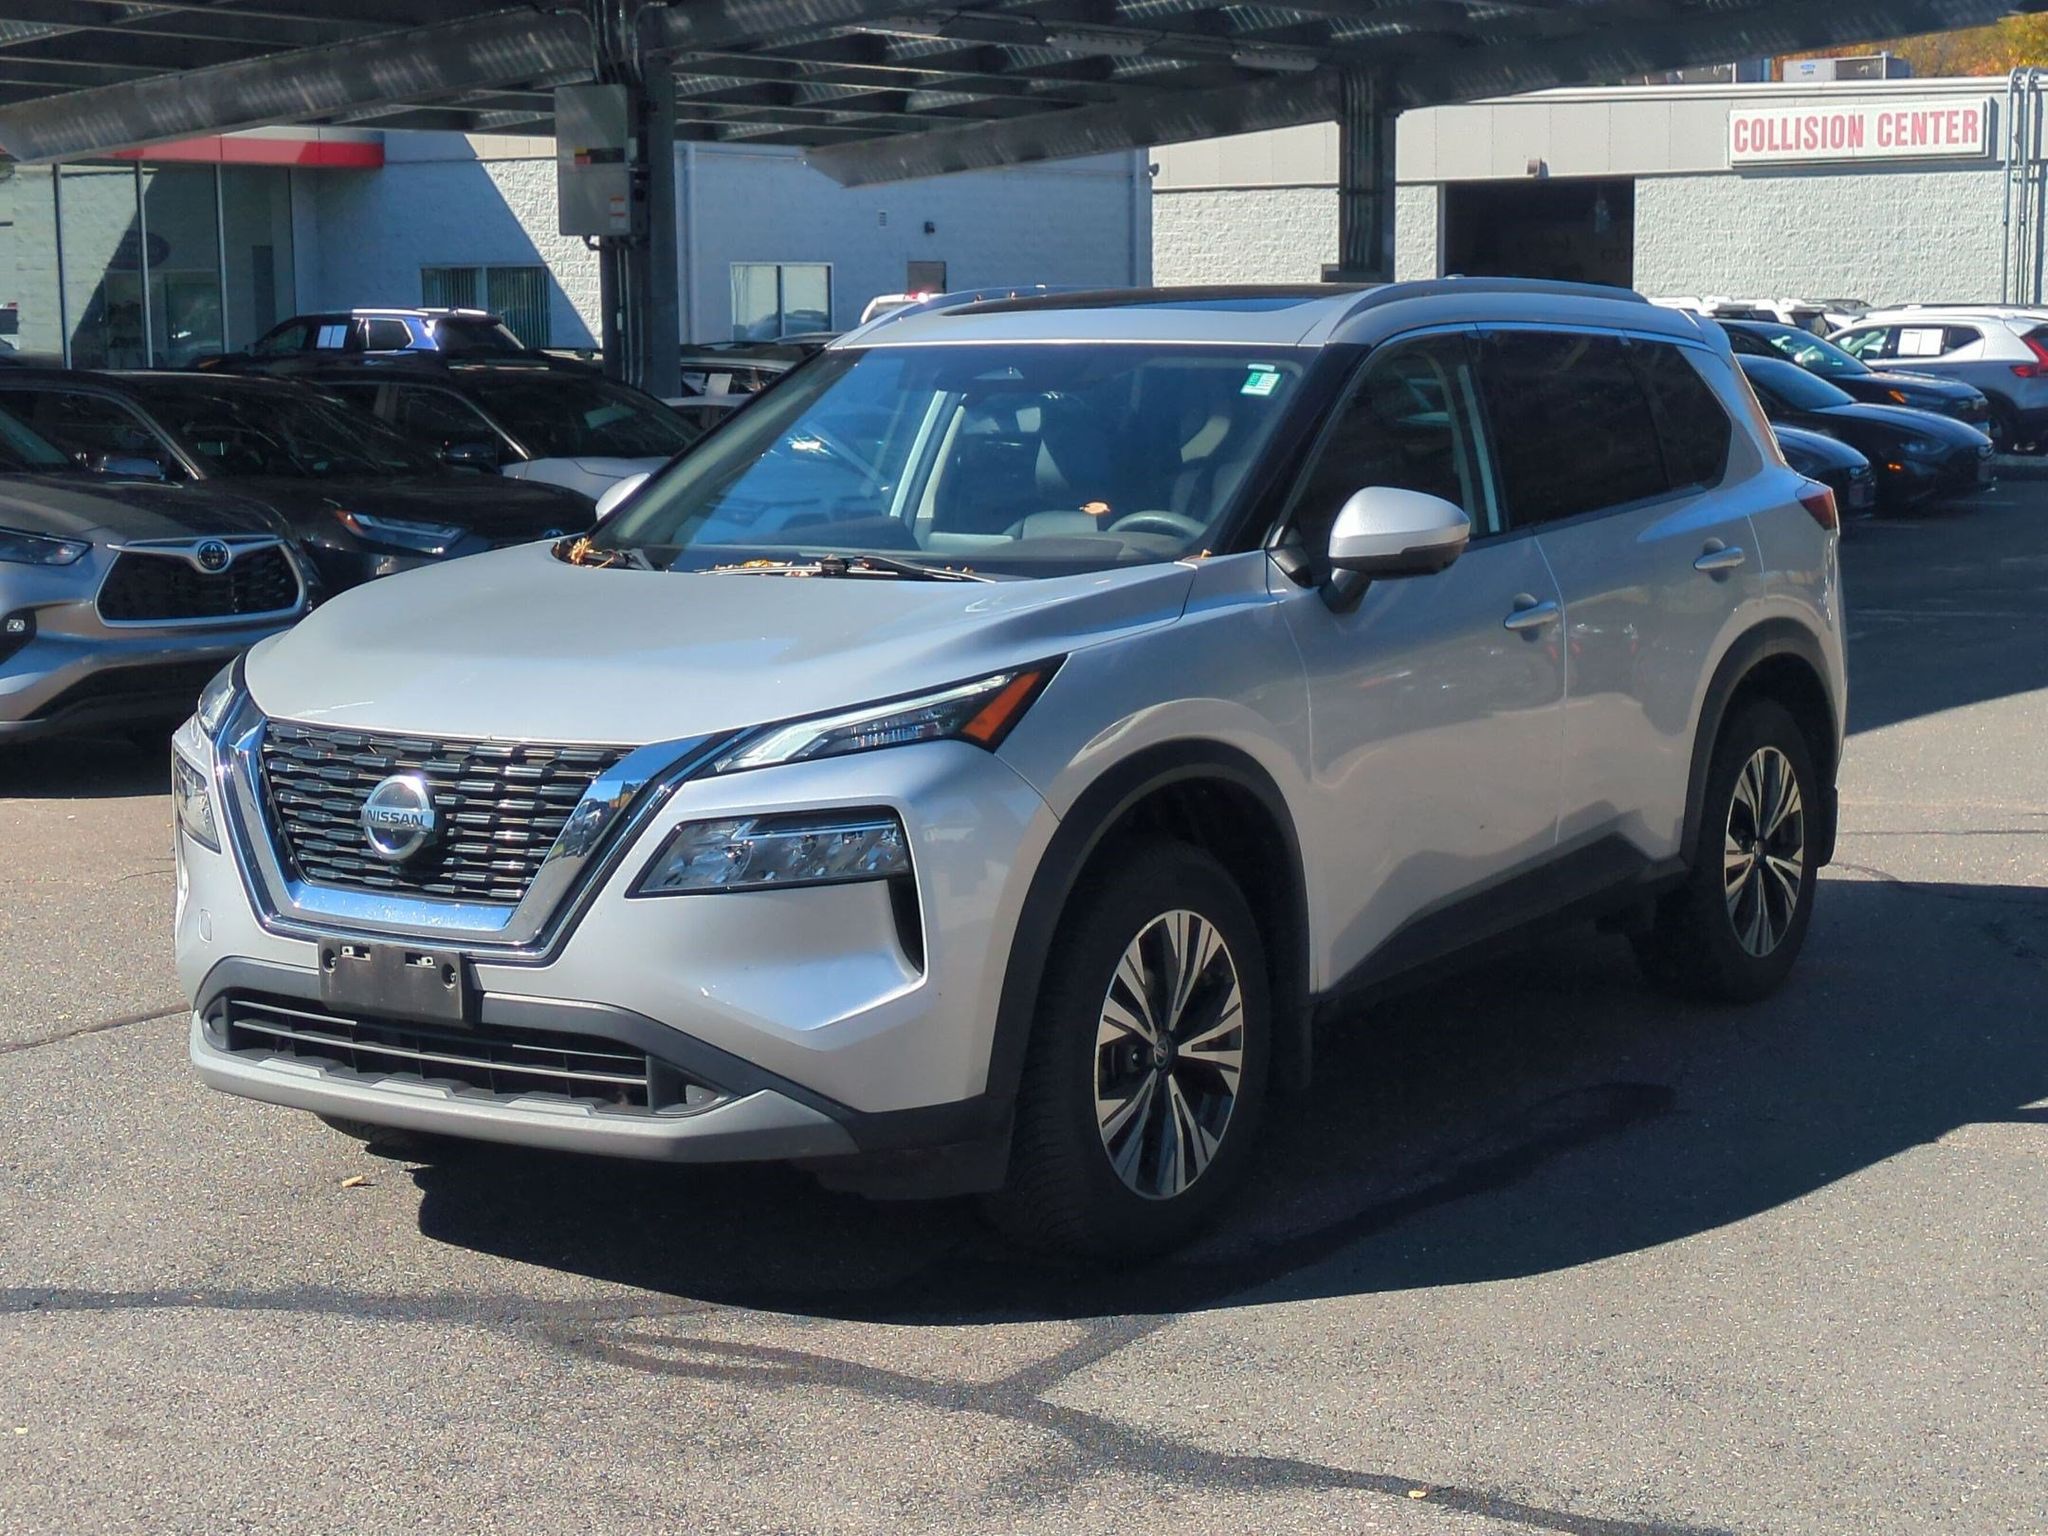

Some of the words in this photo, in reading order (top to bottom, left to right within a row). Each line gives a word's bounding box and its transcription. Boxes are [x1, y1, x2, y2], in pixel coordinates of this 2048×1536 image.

[1734, 114, 1864, 153] COLLISION
[1877, 109, 1978, 148] CENTER
[367, 809, 424, 826] NISSAN
